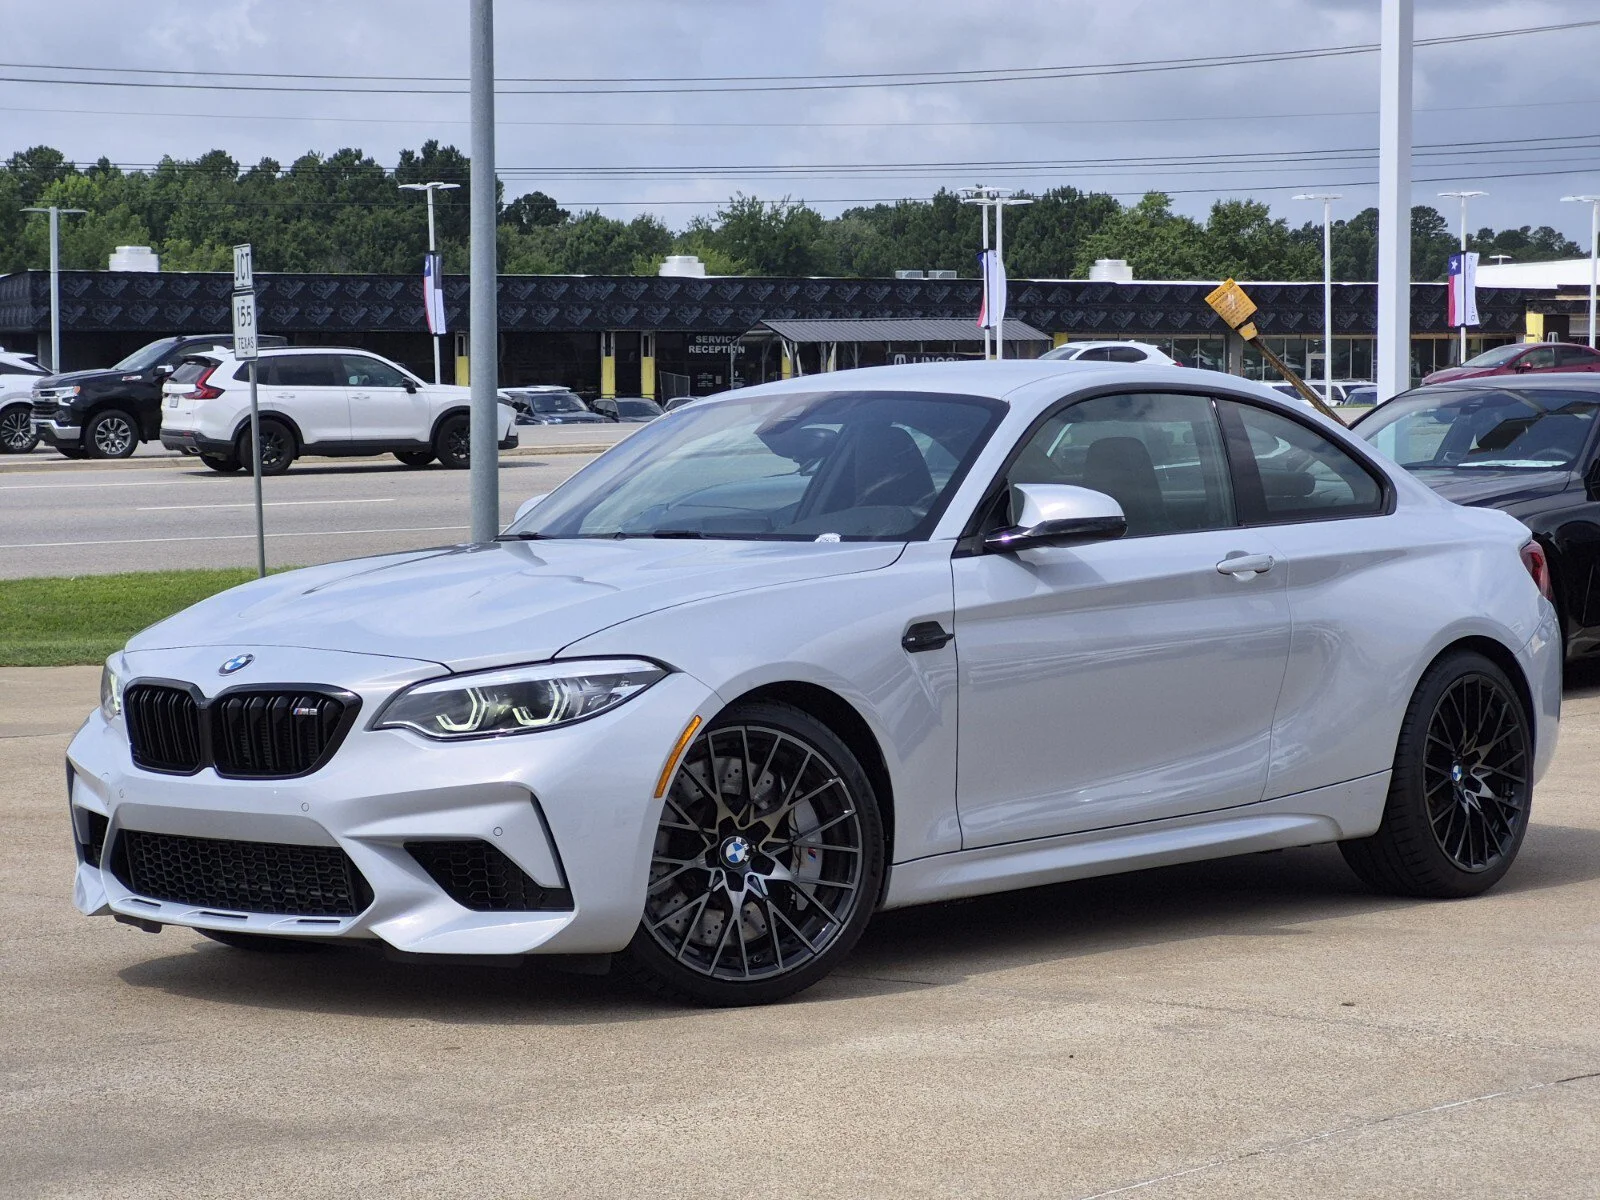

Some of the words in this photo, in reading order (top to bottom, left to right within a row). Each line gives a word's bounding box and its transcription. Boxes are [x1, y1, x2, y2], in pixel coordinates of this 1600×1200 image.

[235, 252, 250, 281] JCT
[236, 305, 252, 327] 155
[237, 337, 254, 350] TEXAS
[688, 345, 746, 354] RECEPTION
